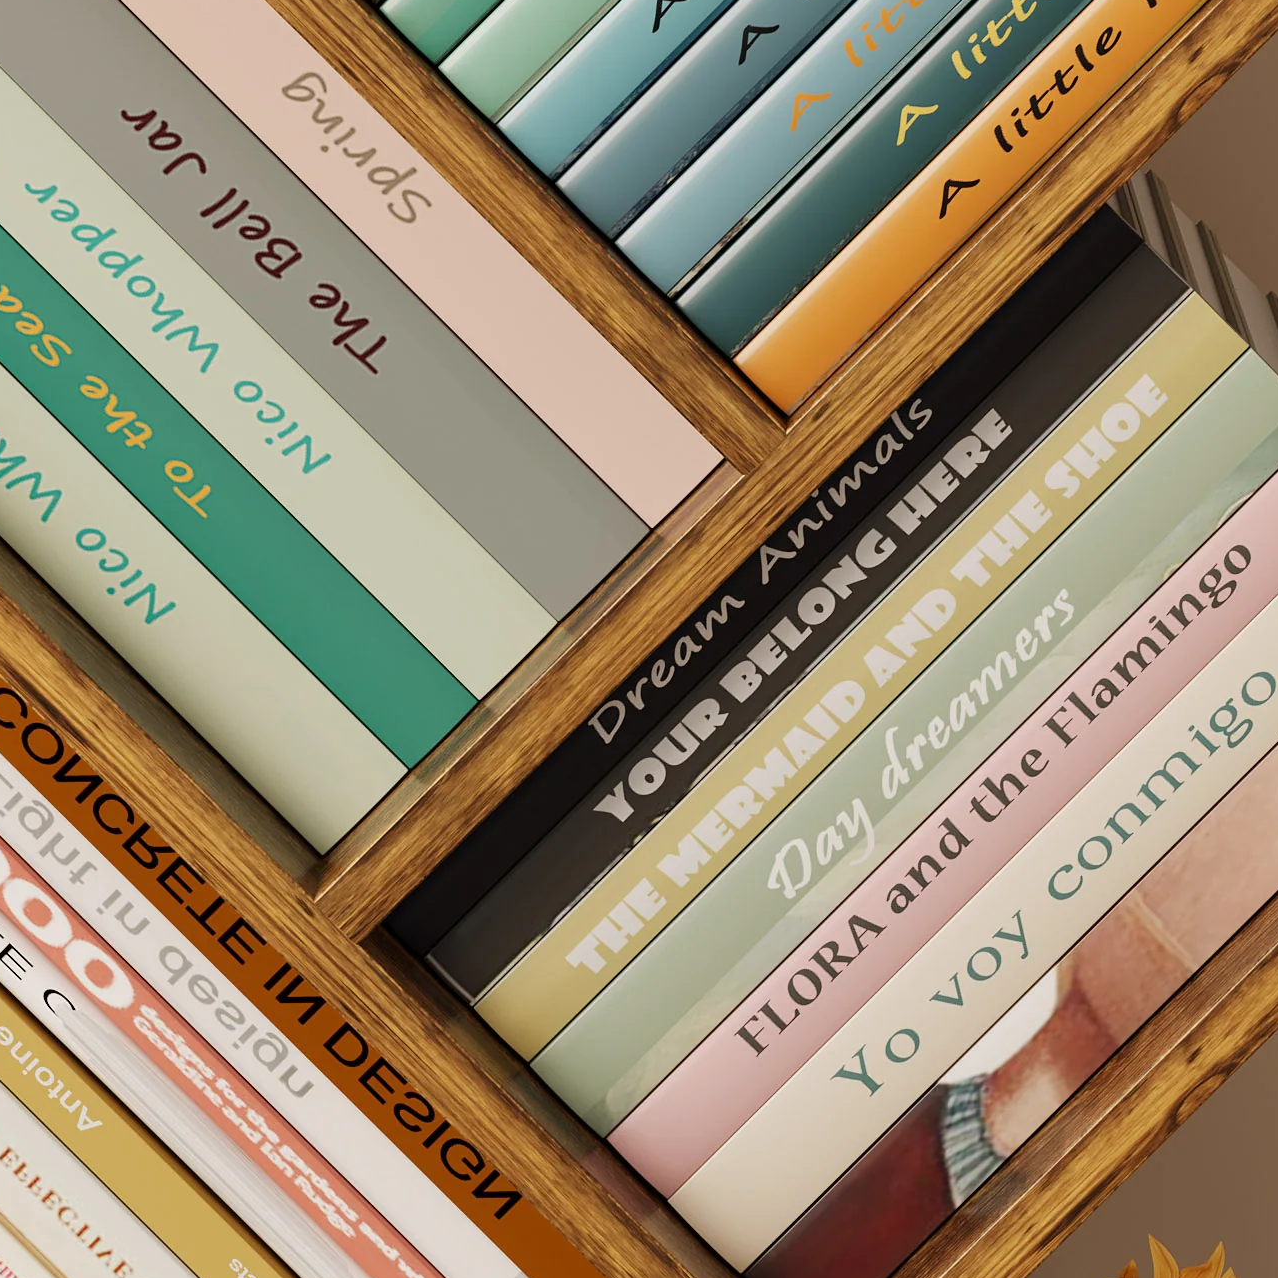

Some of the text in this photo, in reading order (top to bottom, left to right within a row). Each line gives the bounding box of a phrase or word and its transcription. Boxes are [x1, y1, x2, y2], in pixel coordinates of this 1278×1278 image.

[281, 70, 432, 222] Spring
[739, 24, 780, 65] A
[791, 92, 832, 131] A
[897, 104, 940, 145] A
[939, 178, 981, 219] A
[994, 26, 1122, 152] little
[24, 181, 331, 473] Nico Whopper
[120, 108, 387, 373] The Bell Jar
[79, 373, 152, 448] the
[164, 459, 210, 517] To
[75, 526, 176, 623] Nico
[566, 373, 1168, 973] THE MERMAID AND THE SHOE
[587, 397, 932, 745] Dream Animals
[594, 408, 1013, 822] YOUR BELONG HERE
[734, 544, 1252, 1057] FLORA and the Flamingo
[766, 587, 1077, 899] Day dreamers
[830, 671, 1277, 1097] Yo voy conmigo
